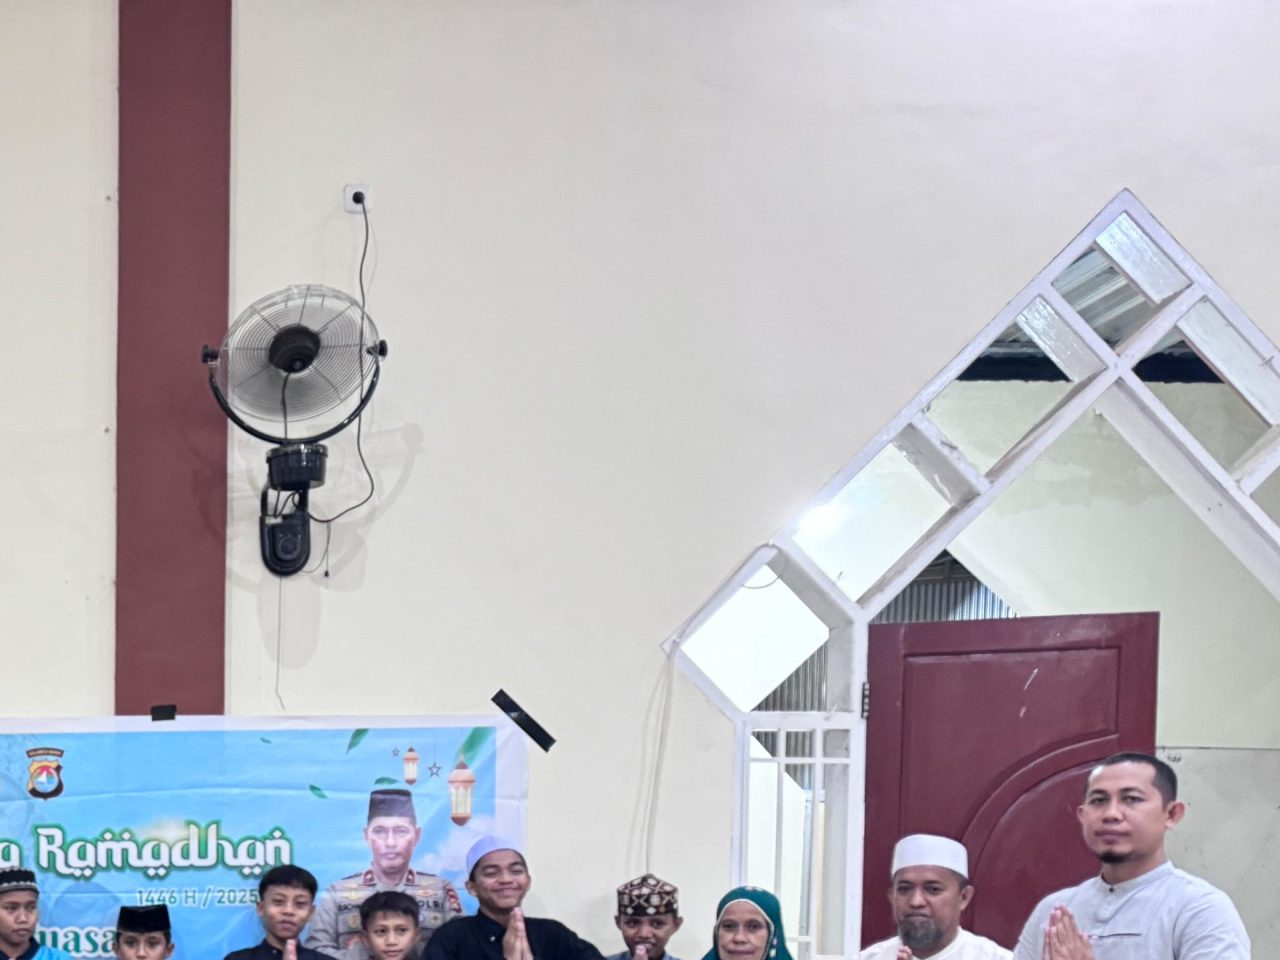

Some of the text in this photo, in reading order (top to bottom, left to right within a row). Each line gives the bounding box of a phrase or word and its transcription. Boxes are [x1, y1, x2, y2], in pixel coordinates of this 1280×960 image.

[35, 822, 292, 878] Ramadhan
[137, 889, 177, 906] 1446
[184, 889, 197, 905] H
[217, 888, 260, 905] 2025
[418, 900, 444, 910] OLRI
[37, 929, 118, 954] uasa
